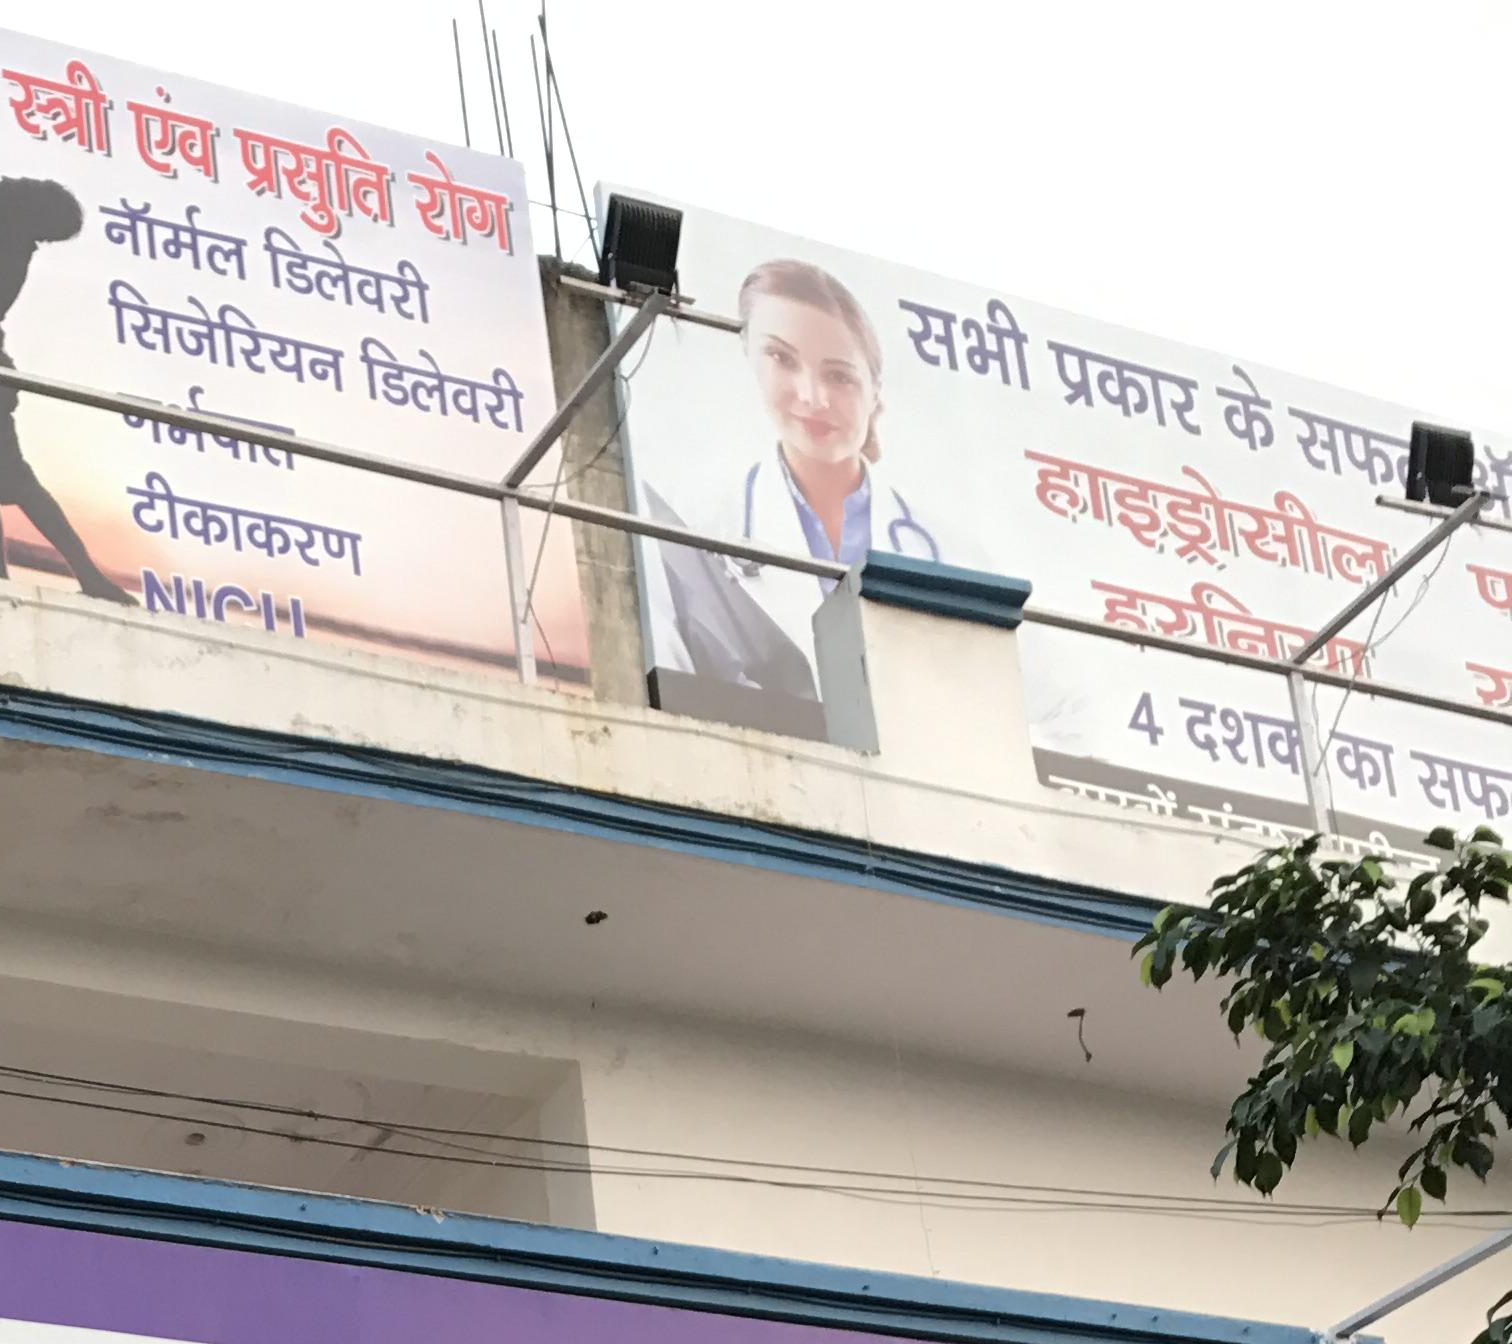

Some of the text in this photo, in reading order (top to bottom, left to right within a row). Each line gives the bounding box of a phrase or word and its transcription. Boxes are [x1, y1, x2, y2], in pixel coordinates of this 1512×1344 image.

[409, 152, 514, 253] रोग
[99, 198, 429, 324] नॉर्मल डिलेवरी
[108, 280, 525, 433] सिजेरियन डिलेवरी
[898, 298, 1030, 390] सभी
[1047, 341, 1201, 435] प्रकार
[1216, 365, 1276, 450] के
[1288, 405, 1416, 492] सफ
[126, 472, 362, 576] टीकाकरण
[1129, 692, 1164, 746] 4
[1330, 730, 1398, 798] का
